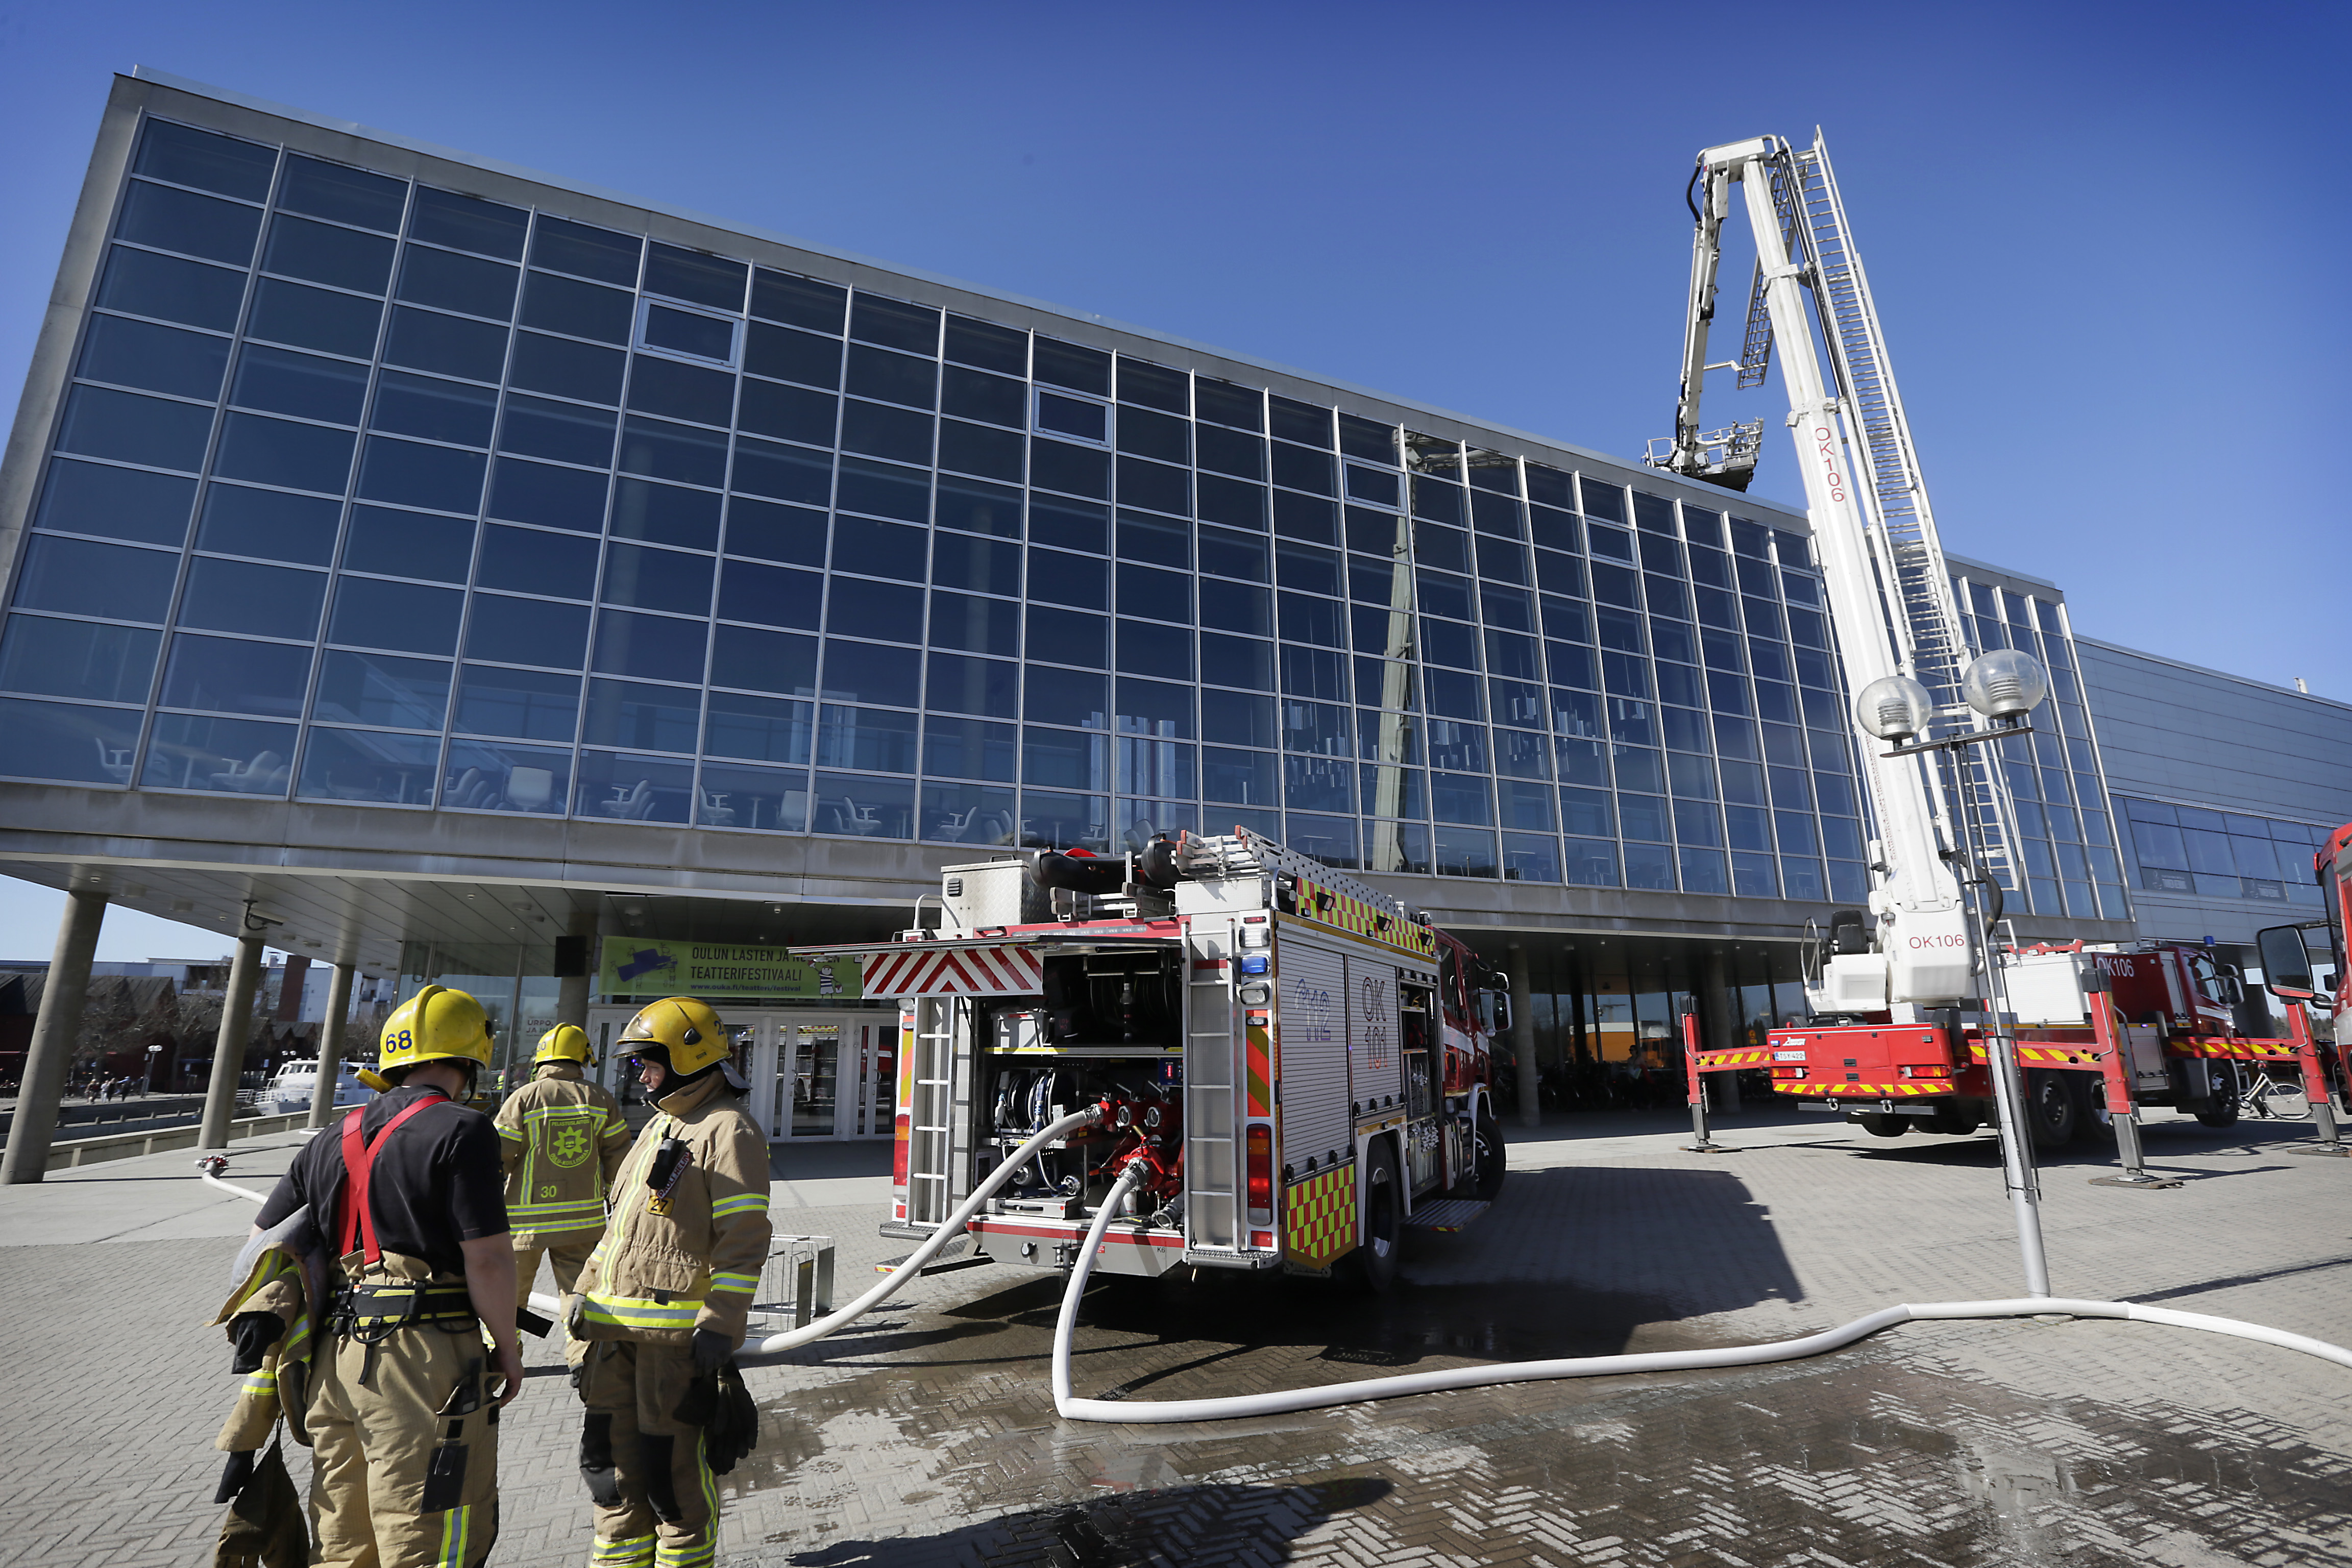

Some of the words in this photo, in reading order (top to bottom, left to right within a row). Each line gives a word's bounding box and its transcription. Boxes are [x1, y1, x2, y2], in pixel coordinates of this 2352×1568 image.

[1815, 427, 1845, 502] OK106
[1909, 934, 1965, 949] OK106
[692, 947, 728, 960] OULUN
[732, 949, 774, 962] LASTEN
[776, 950, 790, 962] JA
[691, 966, 801, 981] TEATTERIFESTIVAALI
[2096, 957, 2134, 977] OK106
[691, 984, 801, 992] www.ouka.fi/teatteri/festival
[1362, 976, 1386, 1021] OK
[1303, 989, 1331, 1041] 112
[386, 1029, 412, 1054] 68
[1365, 1026, 1387, 1069] 101
[550, 1149, 590, 1166] OULU-KOILLISMAA
[541, 1185, 557, 1198] 30
[650, 1198, 669, 1212] 27
